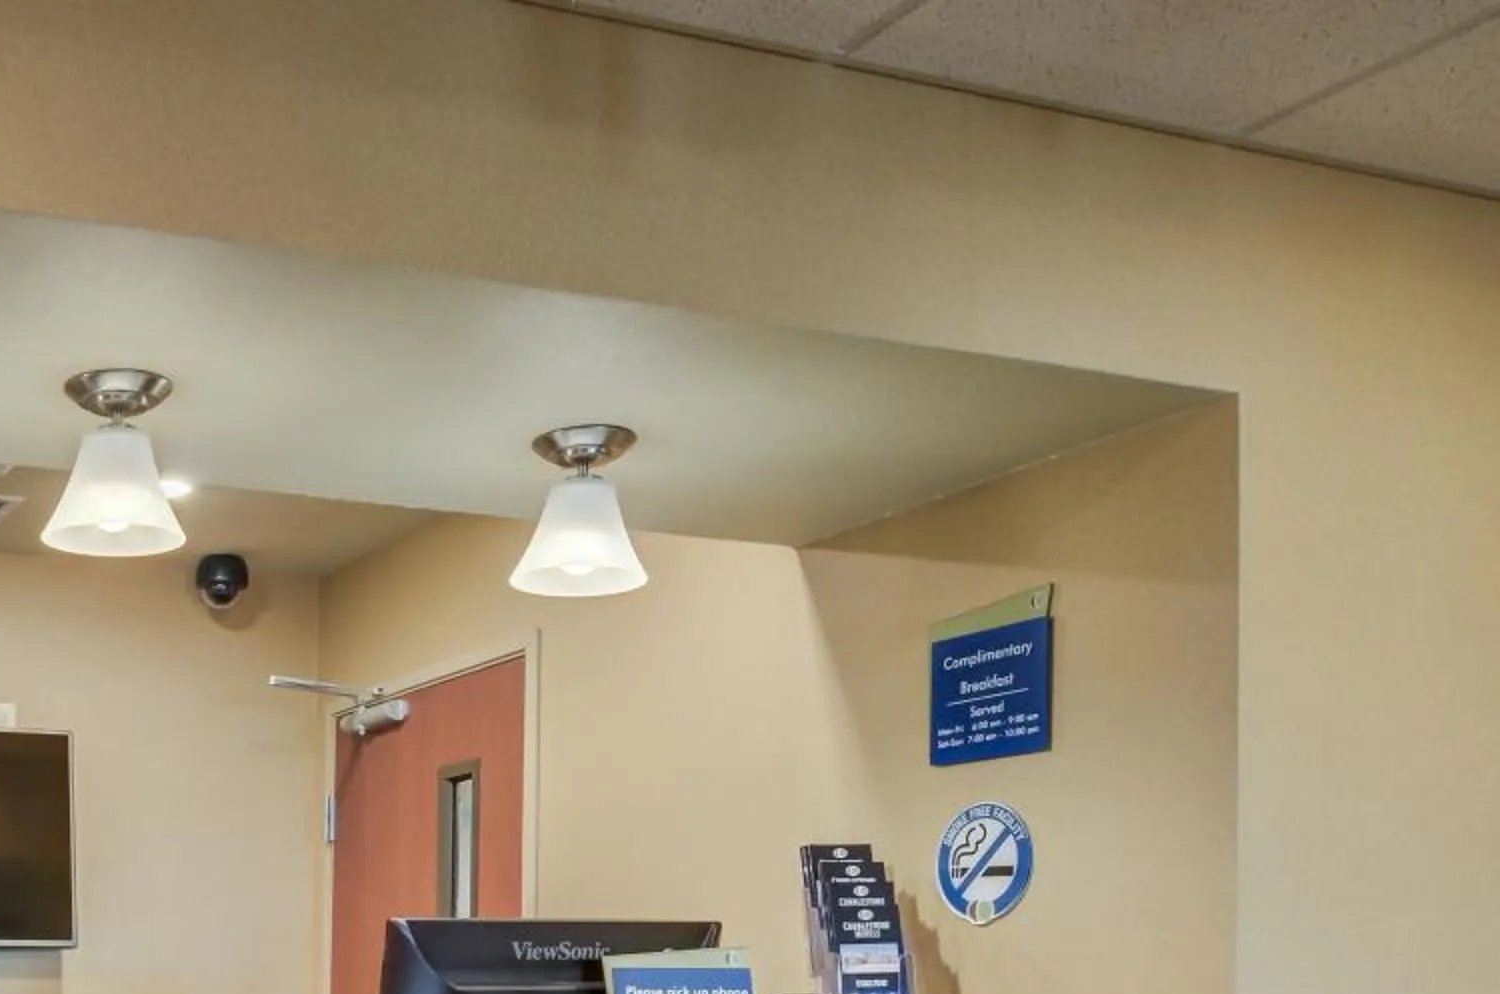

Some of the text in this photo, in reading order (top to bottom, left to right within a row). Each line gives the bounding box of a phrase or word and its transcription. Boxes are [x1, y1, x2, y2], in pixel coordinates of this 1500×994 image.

[943, 641, 1033, 670] Complimentary
[959, 672, 1014, 695] Breakfast
[969, 700, 1005, 719] Served
[512, 941, 611, 961] ViewSonic
